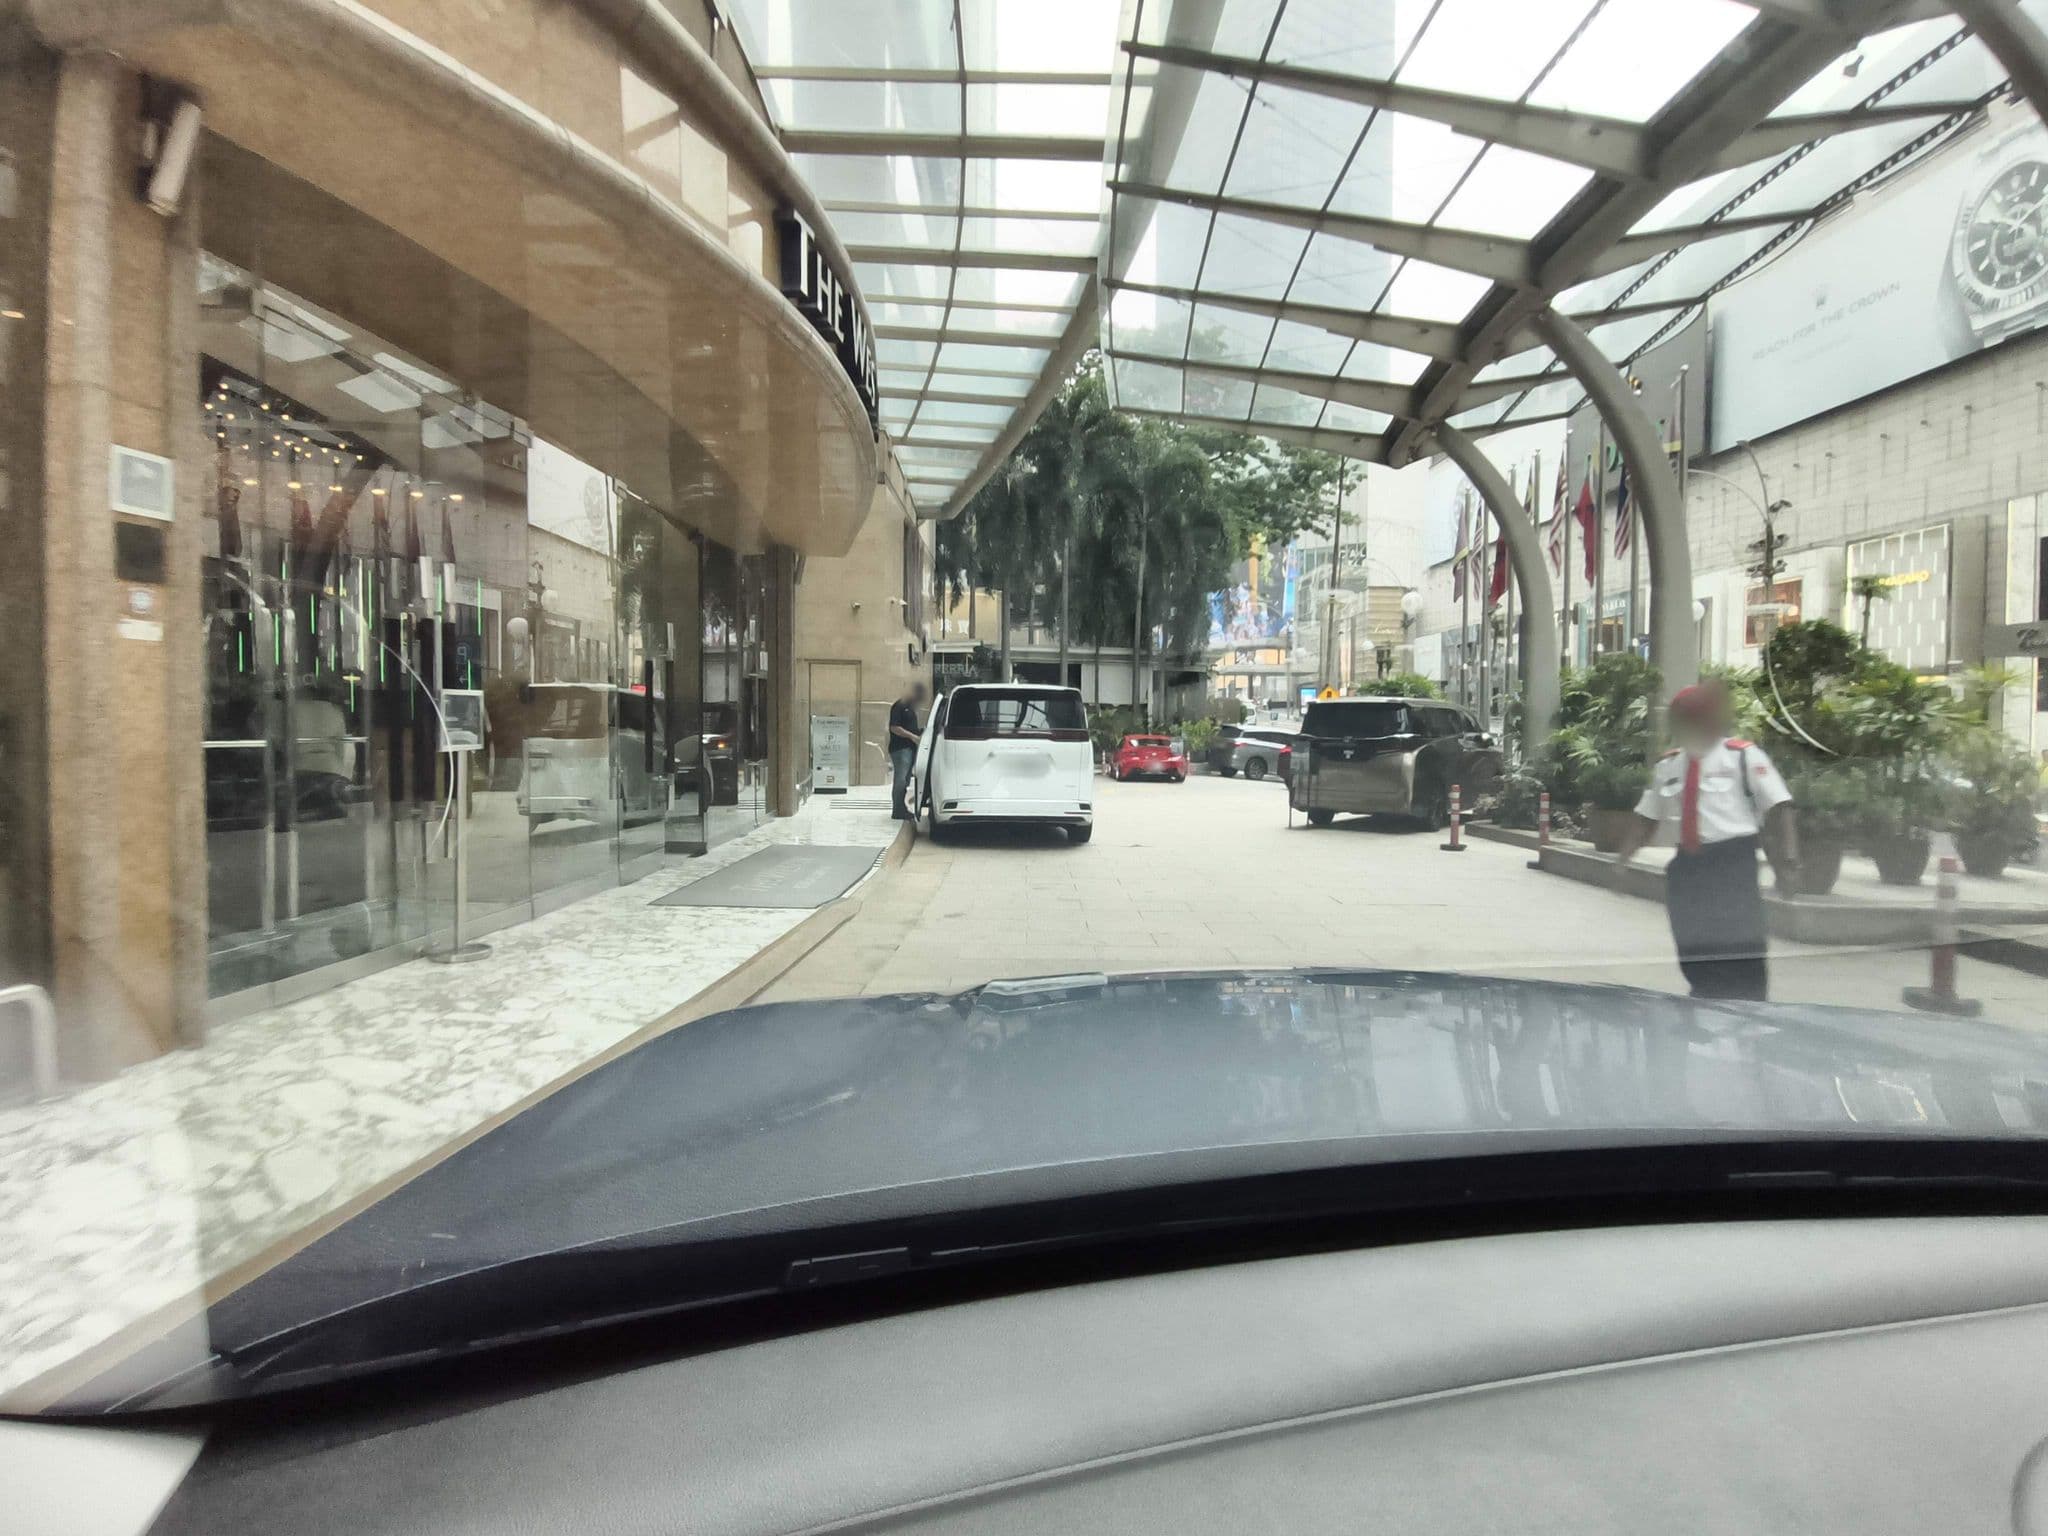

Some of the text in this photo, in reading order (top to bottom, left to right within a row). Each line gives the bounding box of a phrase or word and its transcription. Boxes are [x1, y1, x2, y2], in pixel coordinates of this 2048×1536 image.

[791, 208, 845, 344] THE
[1792, 322, 1816, 343] FOR
[1820, 308, 1844, 327] THE
[1849, 281, 1900, 314] CROWN
